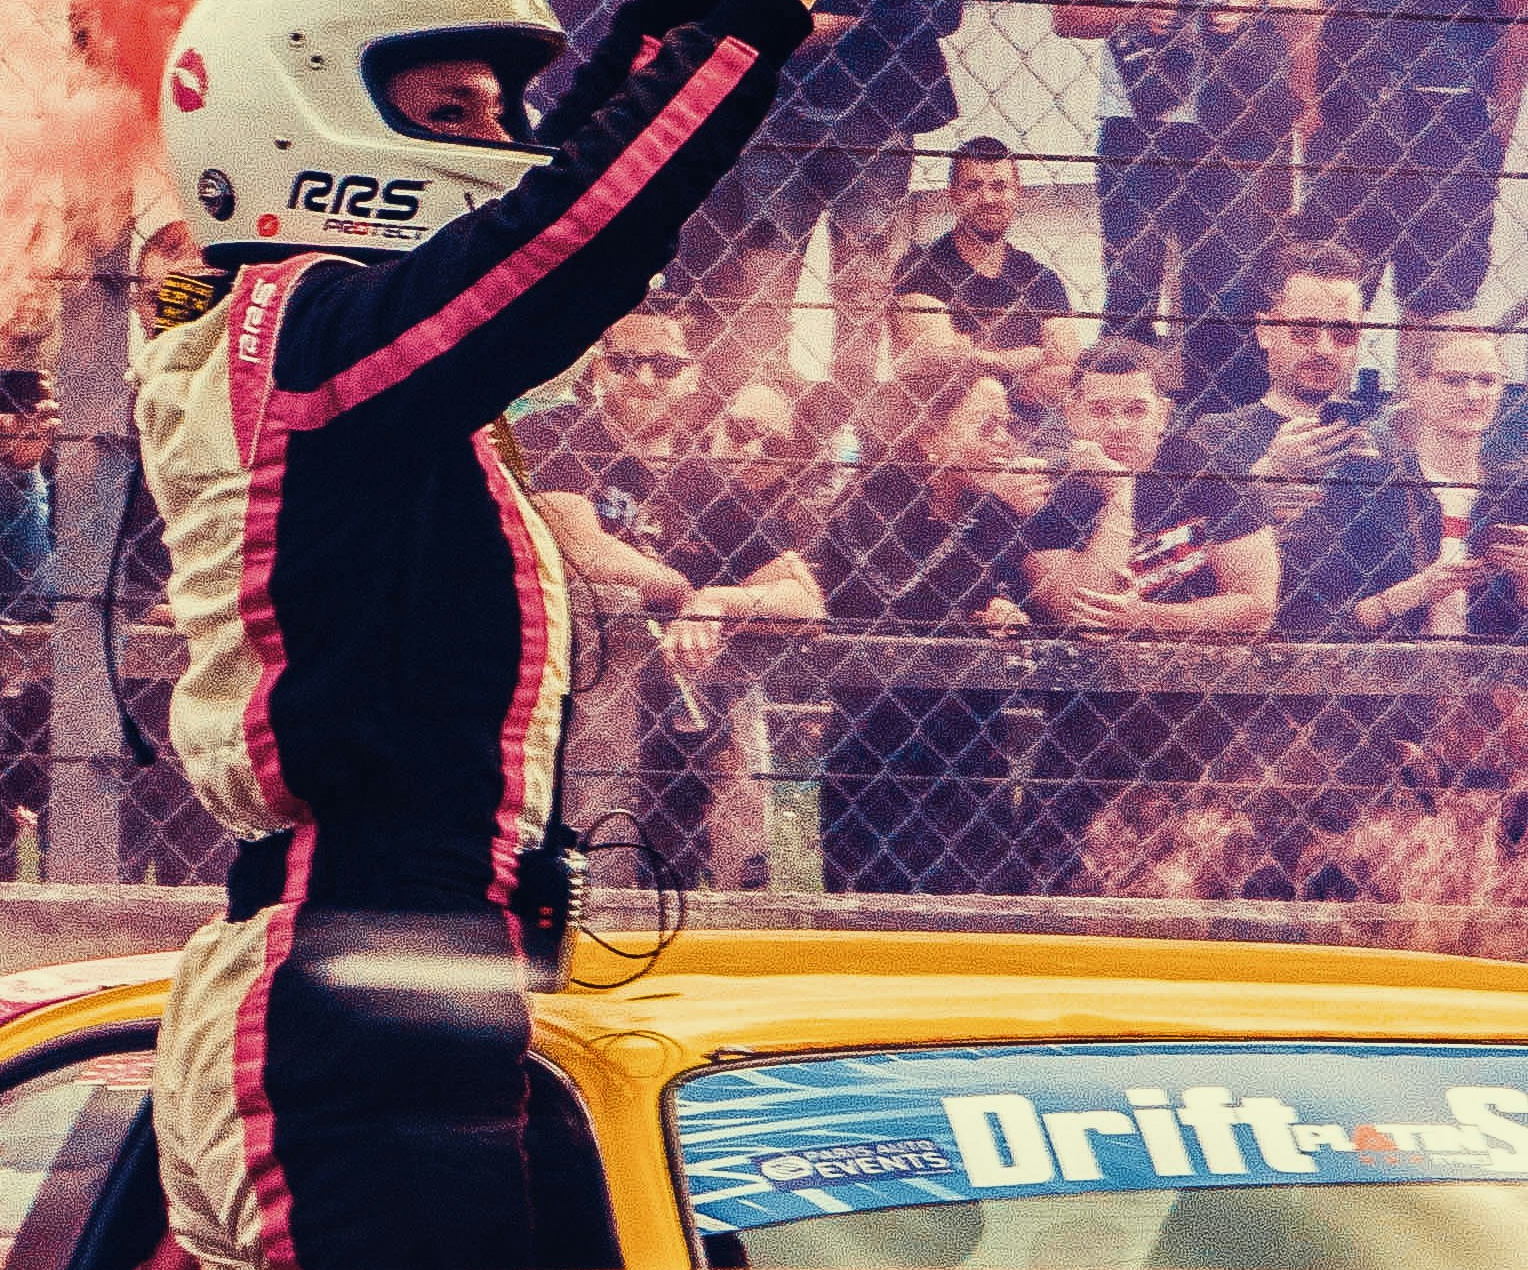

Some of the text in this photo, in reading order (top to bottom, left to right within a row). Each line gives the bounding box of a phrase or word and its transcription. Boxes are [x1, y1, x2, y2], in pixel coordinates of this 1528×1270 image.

[287, 170, 431, 221] RRS
[238, 278, 277, 364] RRS
[814, 1151, 950, 1179] EVENTS
[940, 1085, 1319, 1188] Drift
